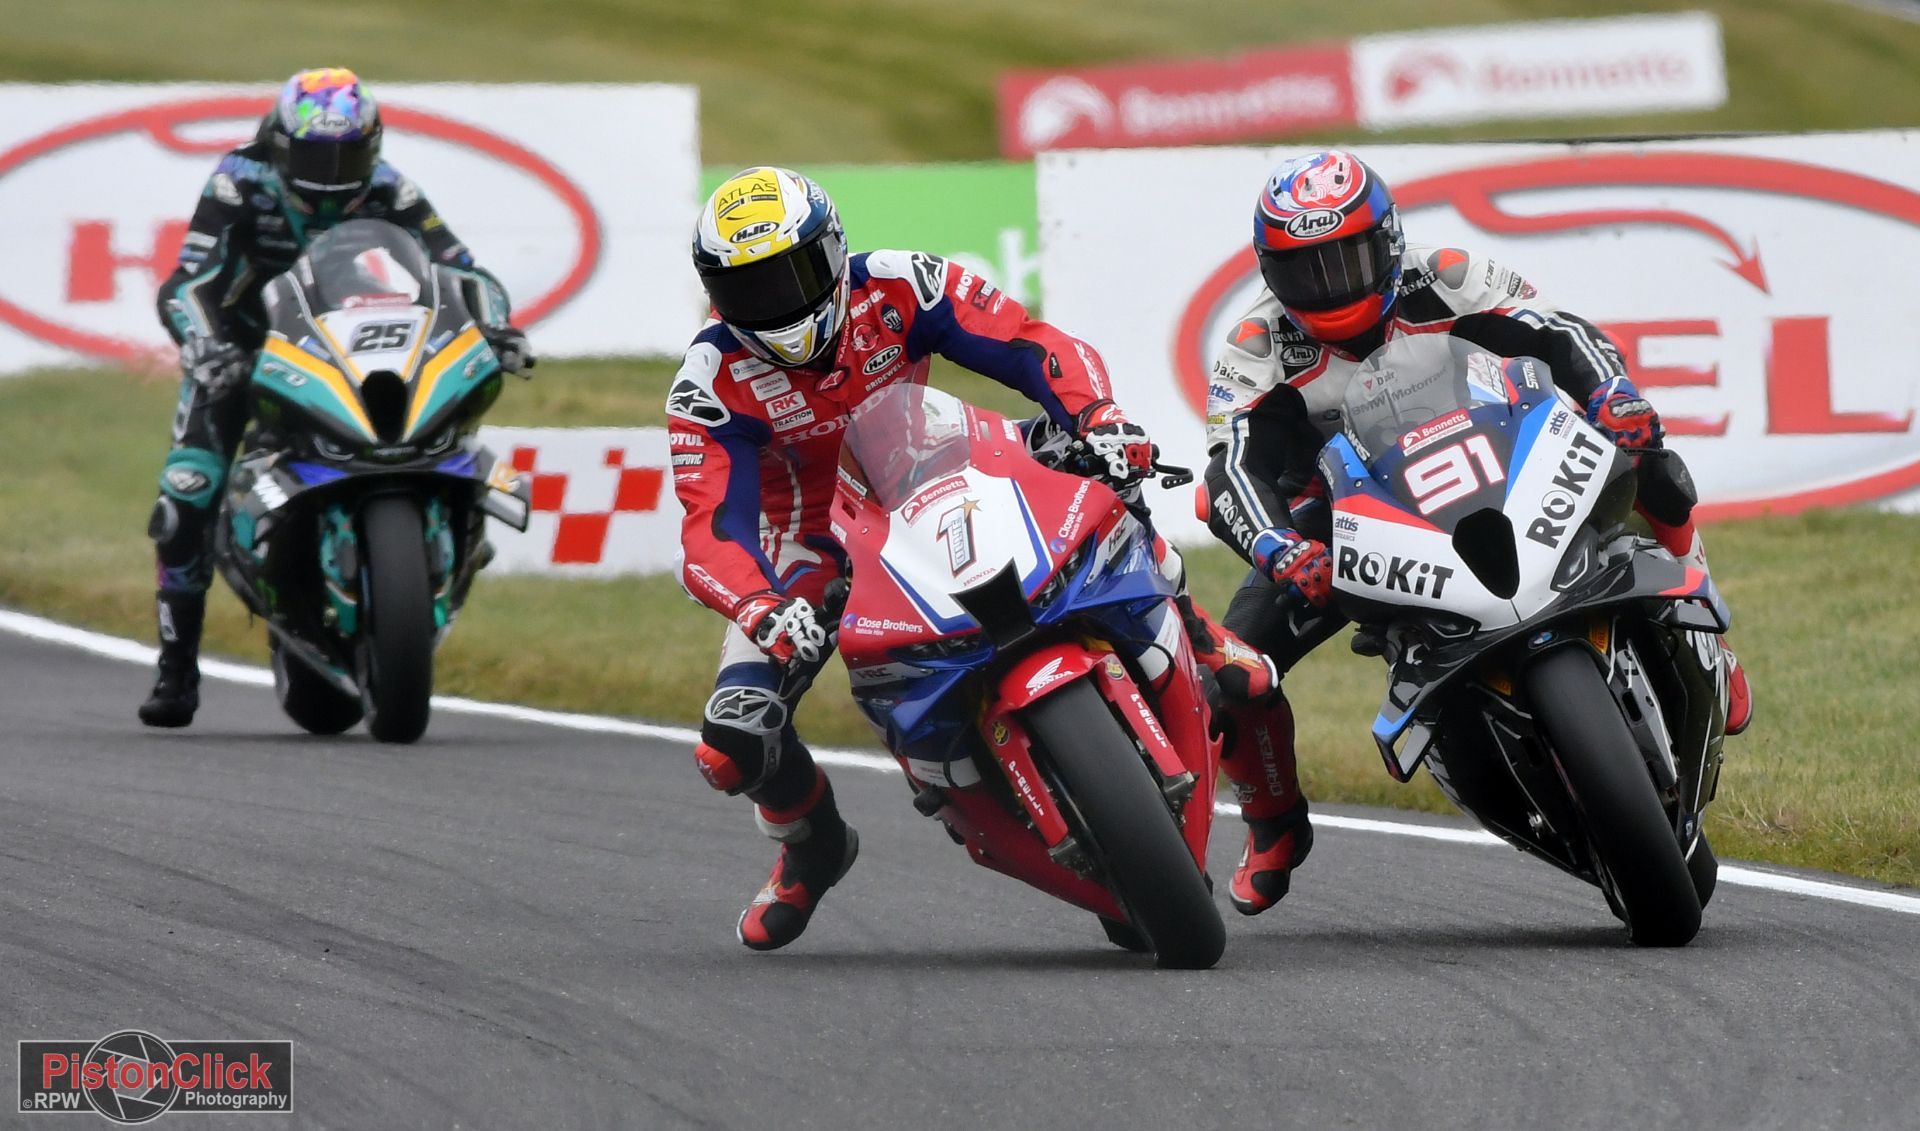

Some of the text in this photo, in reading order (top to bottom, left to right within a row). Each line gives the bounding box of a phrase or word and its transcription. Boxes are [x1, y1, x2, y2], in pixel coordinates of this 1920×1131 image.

[717, 183, 777, 210] ATLAS
[735, 223, 772, 241] HJC
[1292, 212, 1335, 234] Arai
[850, 288, 886, 319] MOTUL
[352, 323, 412, 353] 25
[868, 347, 898, 371] HJC
[865, 361, 906, 391] BRIDEWELL
[771, 395, 798, 413] RK
[774, 410, 812, 428] TRACTION
[1422, 414, 1466, 437] Bennetts
[1404, 433, 1505, 515] 91
[920, 480, 966, 504] Bennetts
[1526, 432, 1604, 549] ROKiT
[1058, 480, 1091, 538] Close Brothers
[1214, 490, 1253, 556] ROKi
[963, 568, 996, 587] HONDA
[1338, 545, 1454, 599] ROKiT
[857, 616, 923, 633] Close Brothers
[1029, 669, 1074, 697] HONDA
